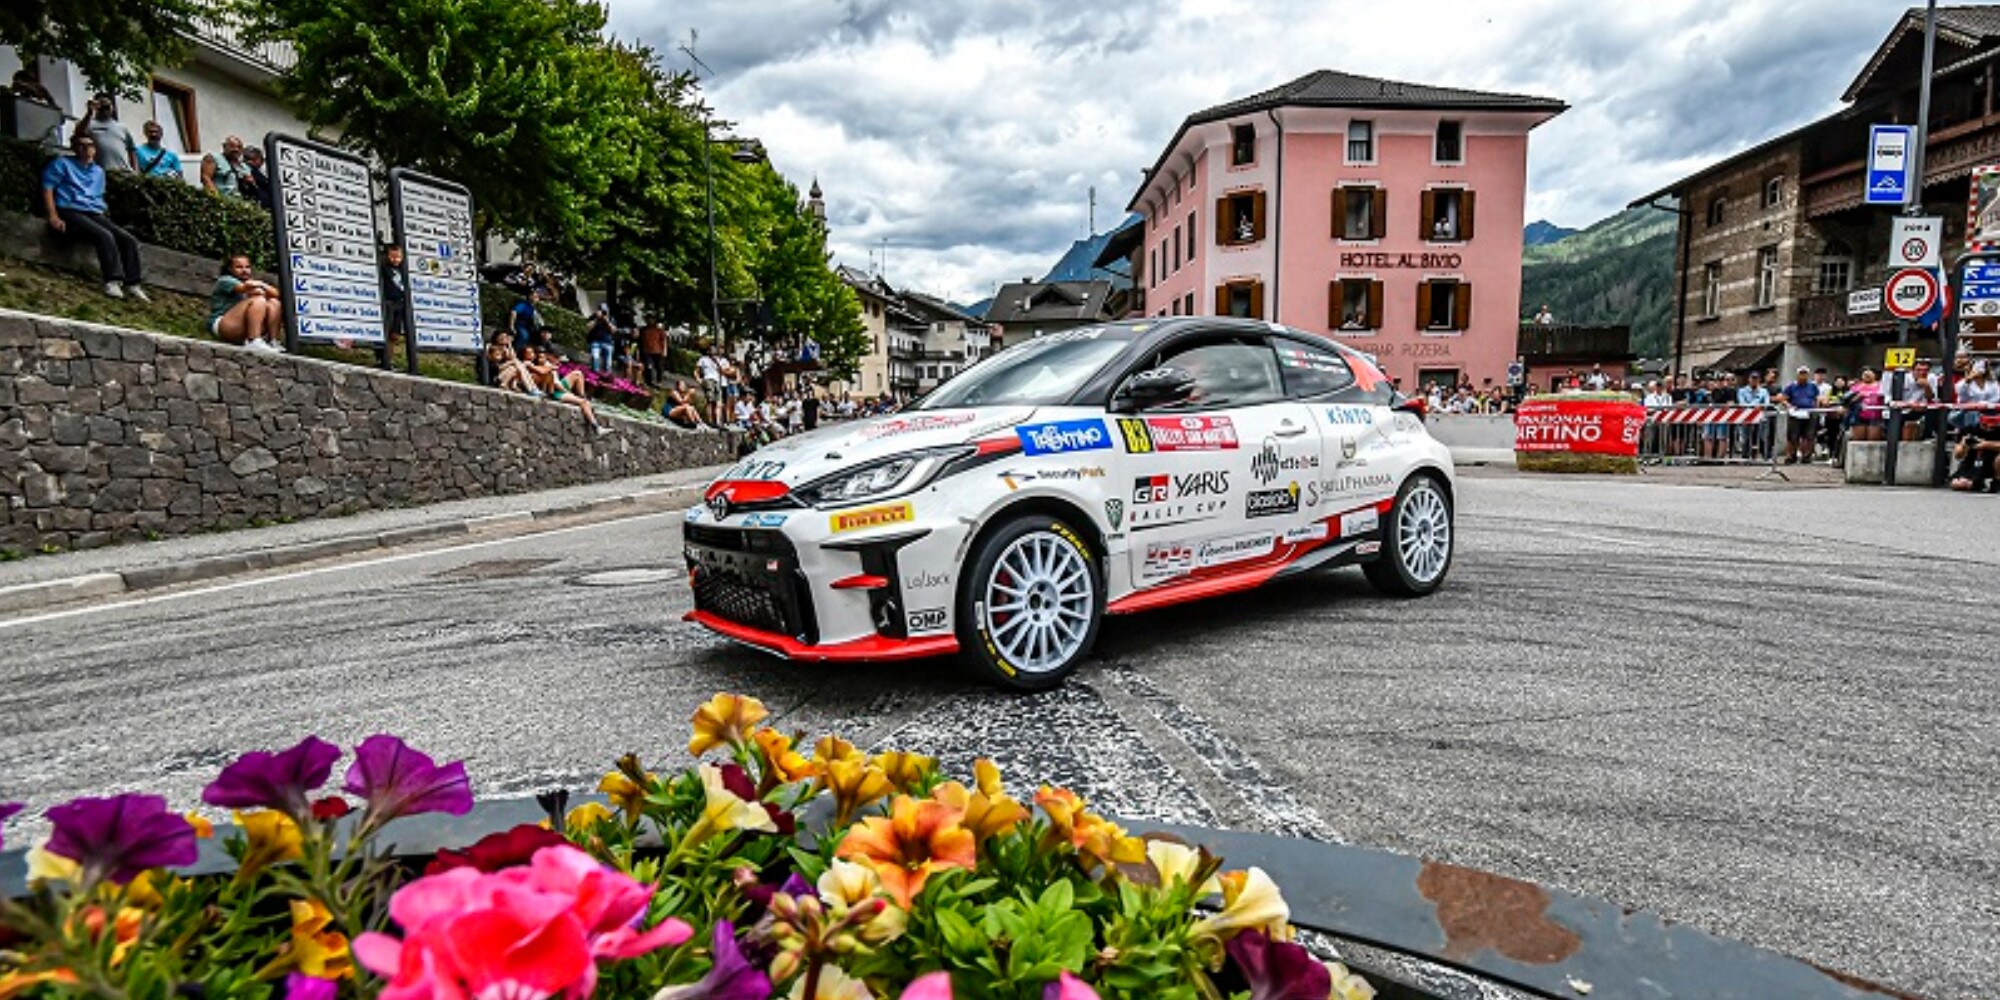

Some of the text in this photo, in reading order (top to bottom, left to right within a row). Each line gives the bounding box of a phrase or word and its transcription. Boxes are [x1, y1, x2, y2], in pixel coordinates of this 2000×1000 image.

[1340, 253, 1462, 269] HOTEL AL BIVIO
[1894, 352, 1910, 364] 12
[1027, 426, 1102, 451] TRENTINO
[1120, 418, 1151, 452] 83
[1134, 471, 1229, 503] GR YARIS
[838, 505, 906, 530] PIRELLI
[1130, 501, 1227, 522] RALLY CUP
[908, 610, 947, 629] OMP
